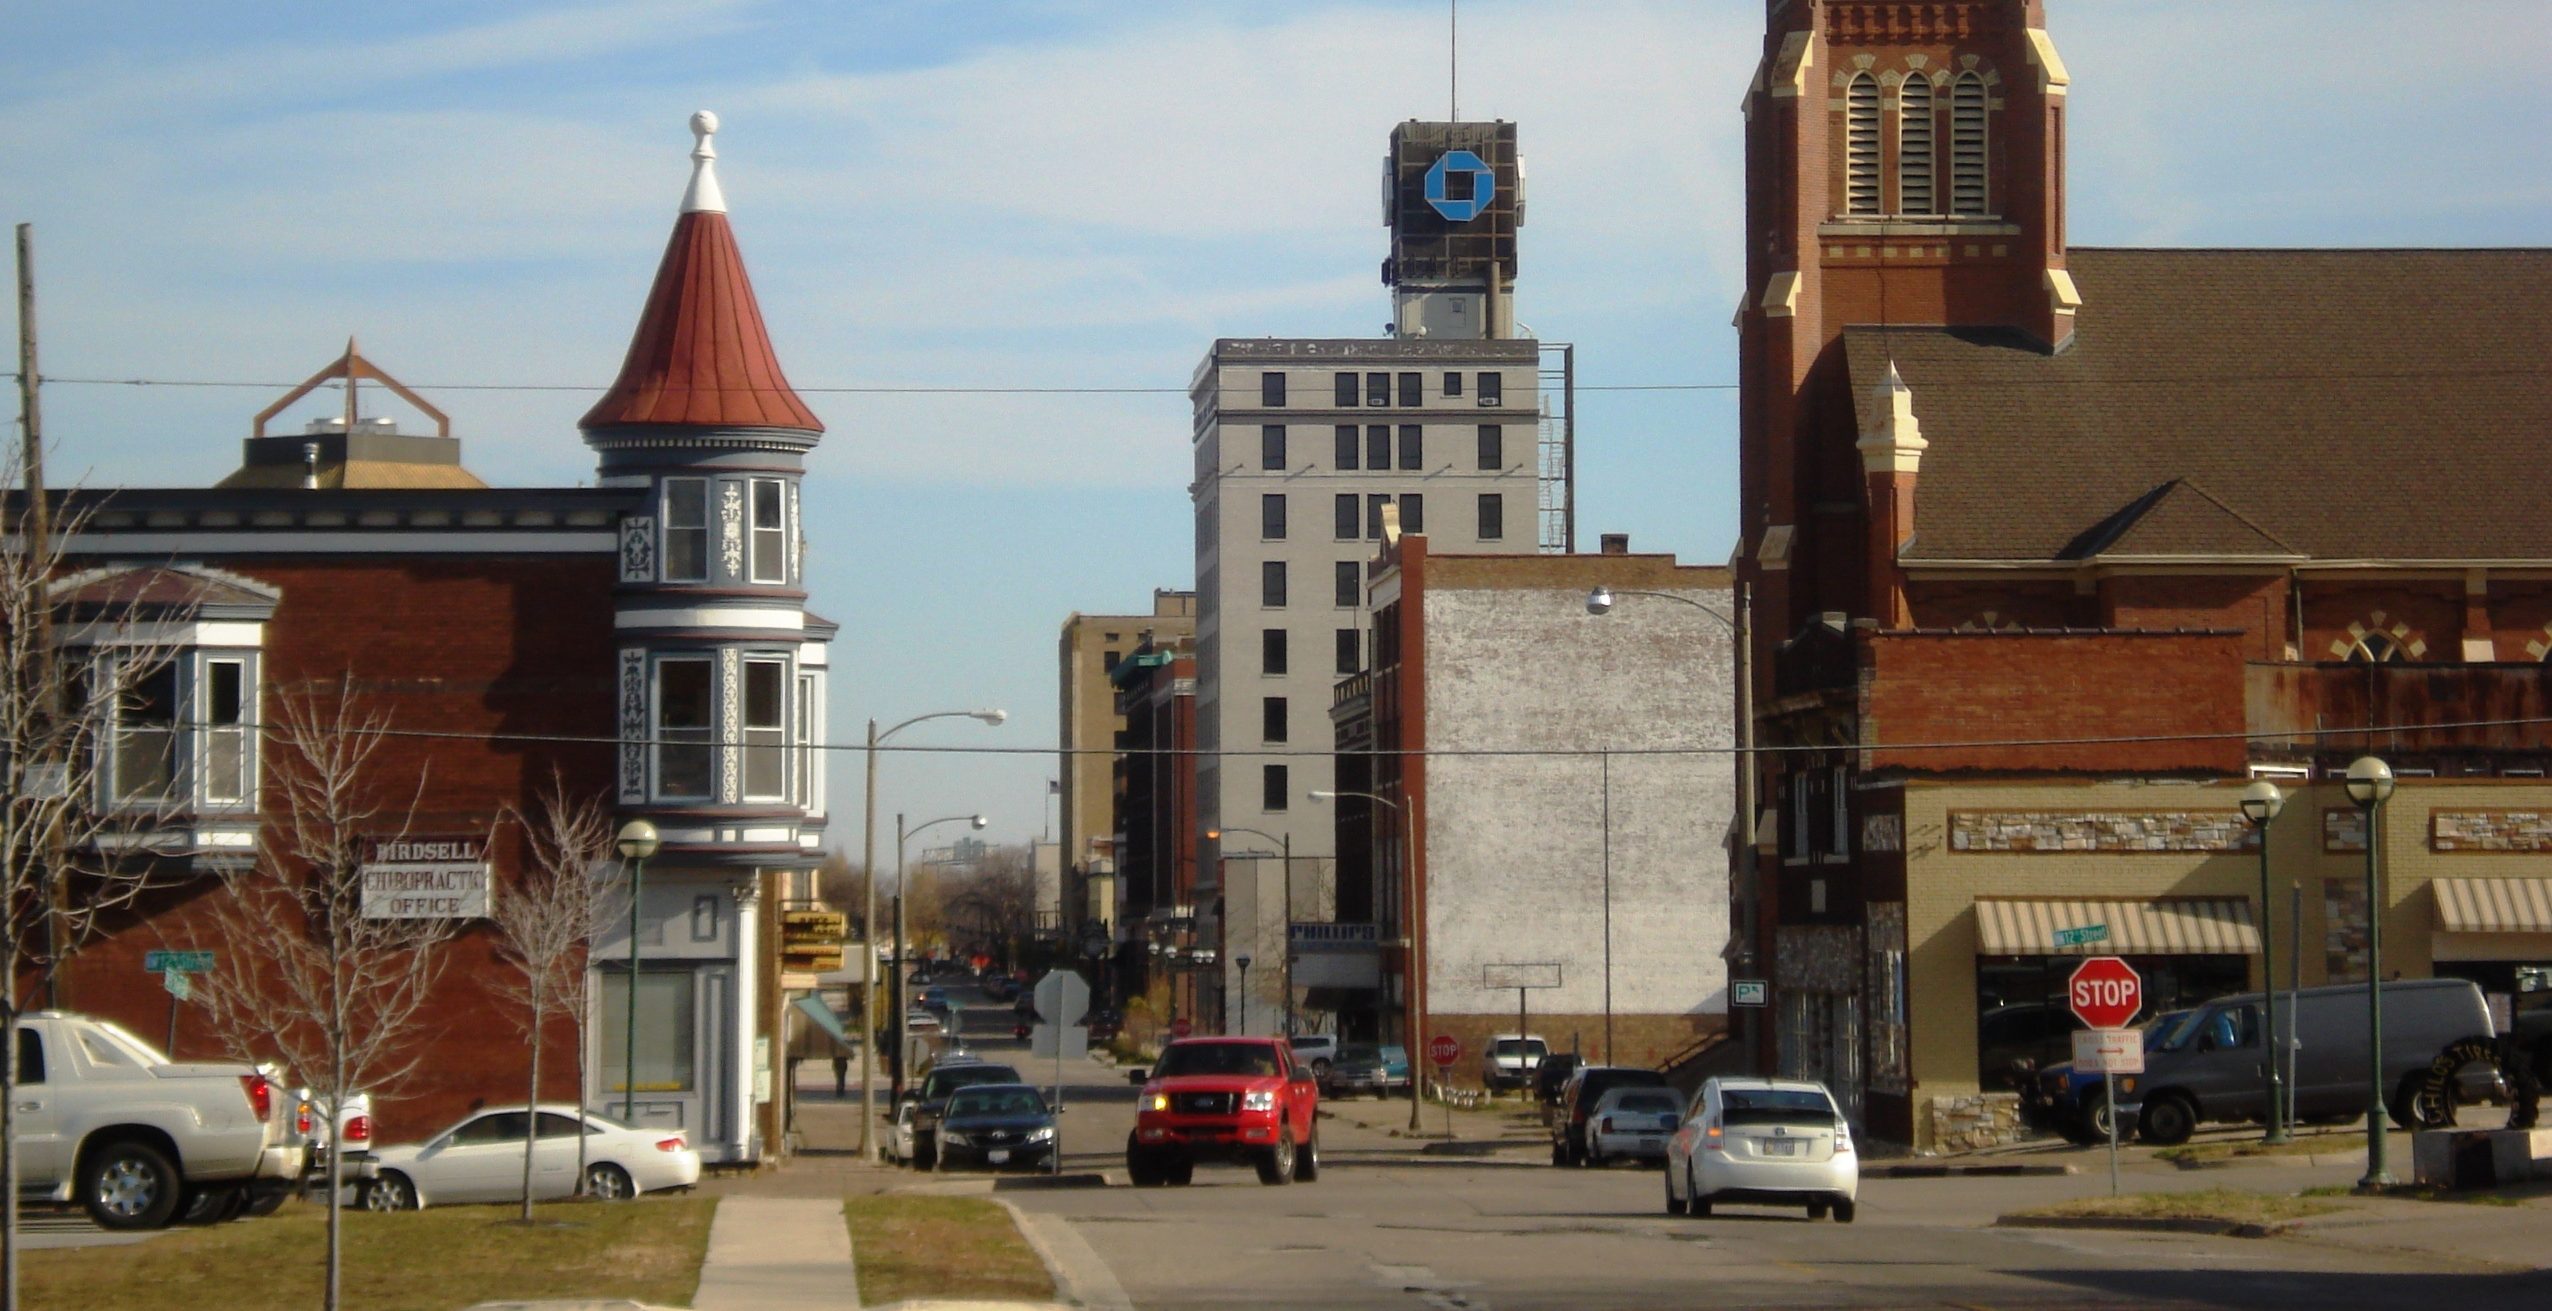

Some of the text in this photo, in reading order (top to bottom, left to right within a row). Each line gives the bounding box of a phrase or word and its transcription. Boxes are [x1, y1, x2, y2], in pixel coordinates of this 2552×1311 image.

[376, 842, 475, 861] BIRDSELL
[365, 870, 484, 891] CHIROPRACTIC
[390, 898, 460, 914] OFFICE
[2075, 980, 2136, 1007] STOP
[1430, 1044, 1457, 1058] STOP
